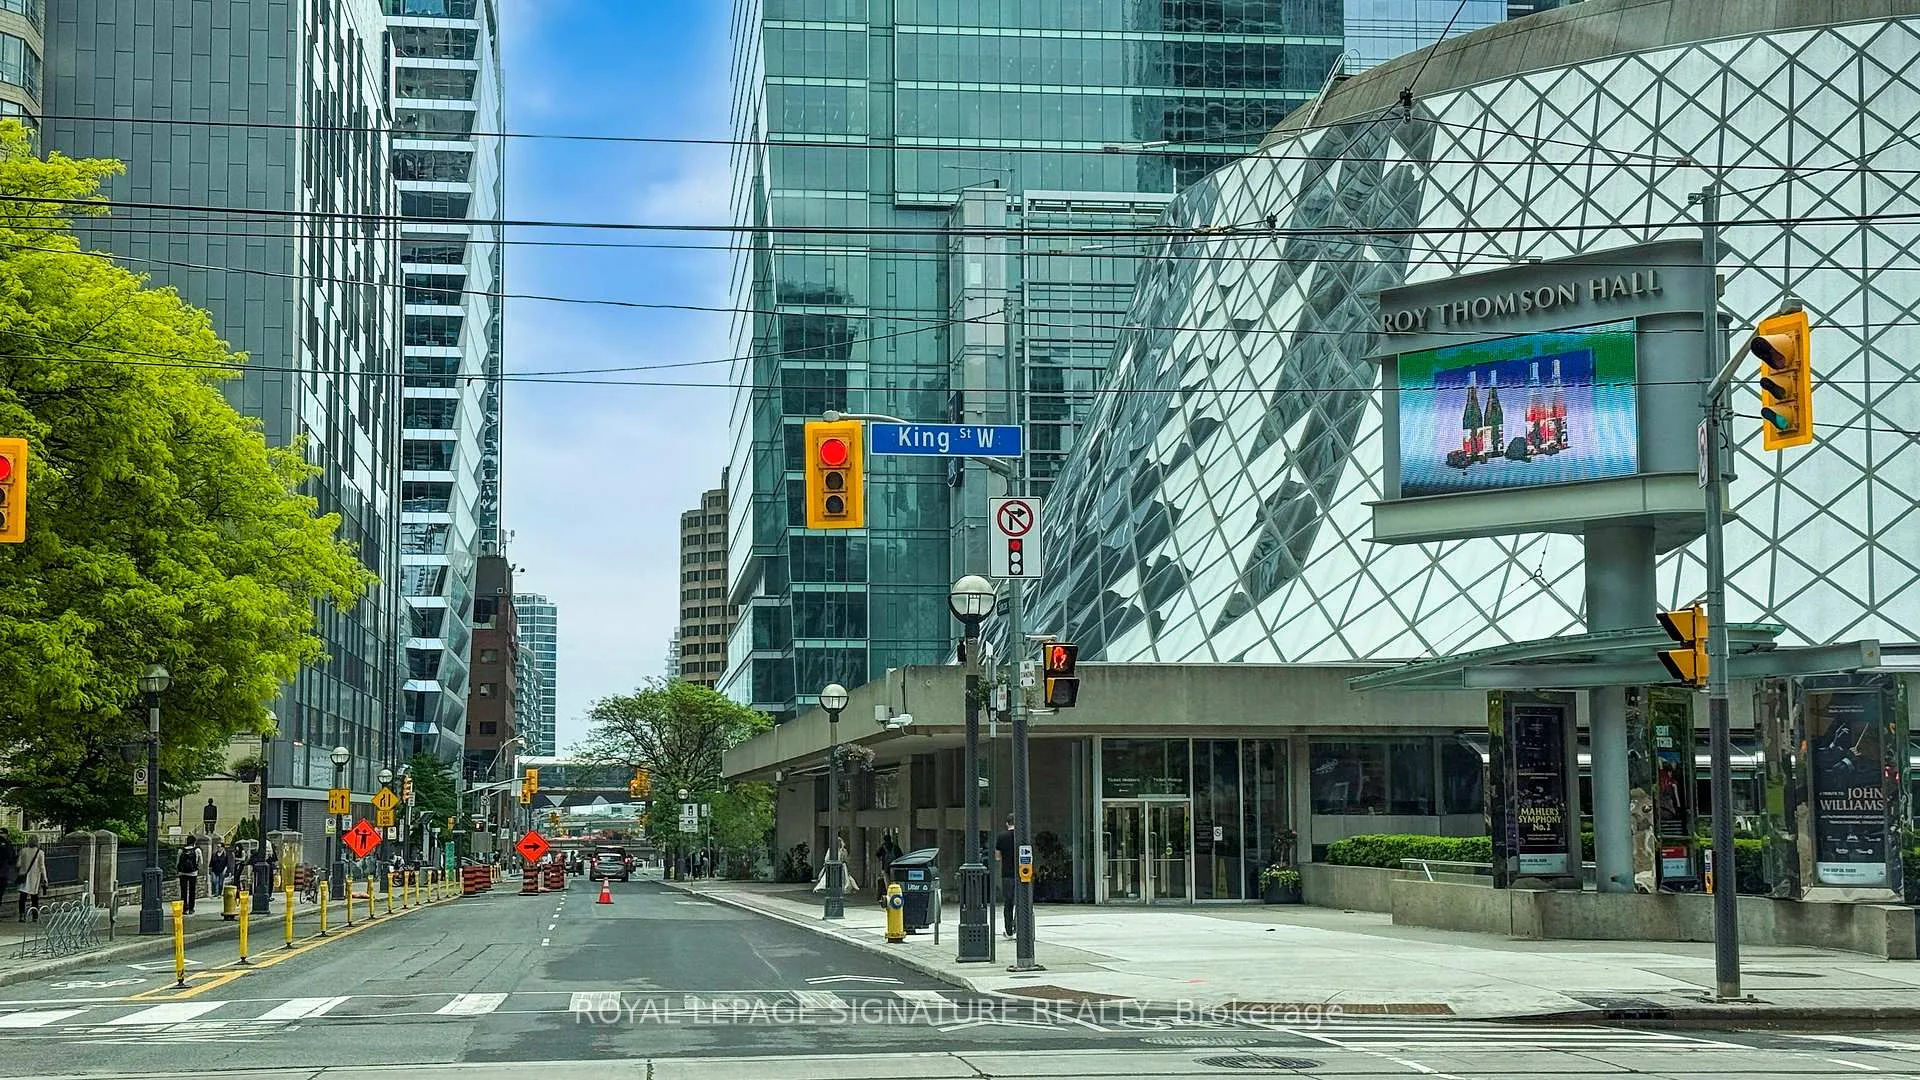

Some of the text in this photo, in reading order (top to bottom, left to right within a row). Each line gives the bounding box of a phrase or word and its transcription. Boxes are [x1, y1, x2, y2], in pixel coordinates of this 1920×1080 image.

[1381, 270, 1663, 333] ROY THOMSON HALL
[898, 426, 994, 453] King St W
[1847, 787, 1883, 800] JOHN
[1520, 807, 1559, 816] MAHLER'S
[1820, 800, 1884, 811] WILLIAMS
[1518, 815, 1561, 824] SYMPHONY
